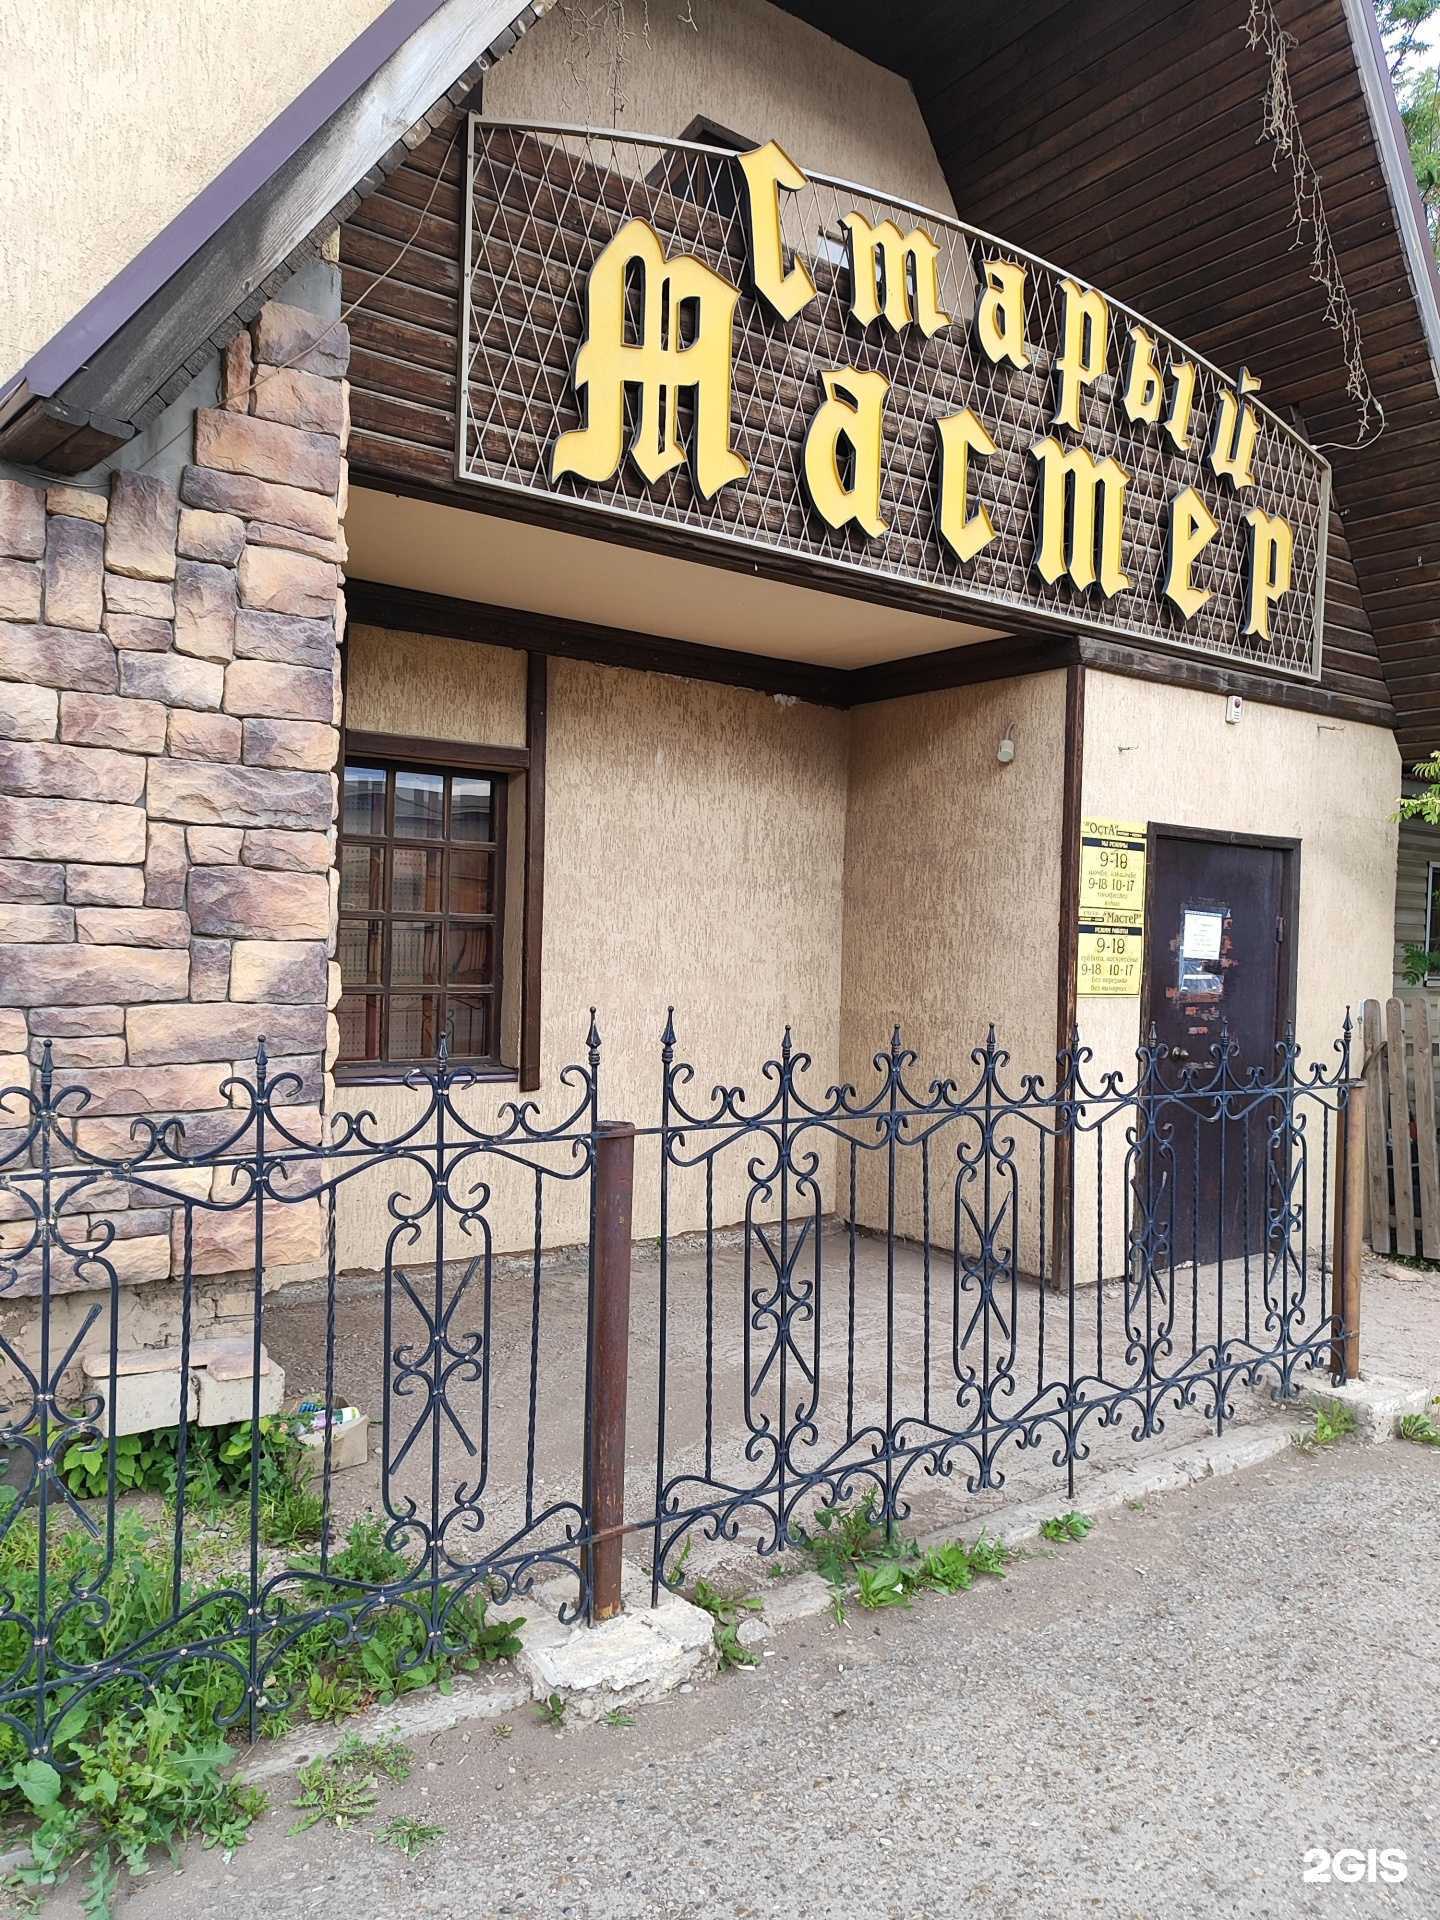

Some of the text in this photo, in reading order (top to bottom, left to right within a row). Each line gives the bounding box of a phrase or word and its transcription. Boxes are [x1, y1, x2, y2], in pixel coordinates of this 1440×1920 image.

[550, 217, 1294, 643] Мастер
[736, 139, 1262, 490] Старый
[1096, 937, 1125, 955] 9-18
